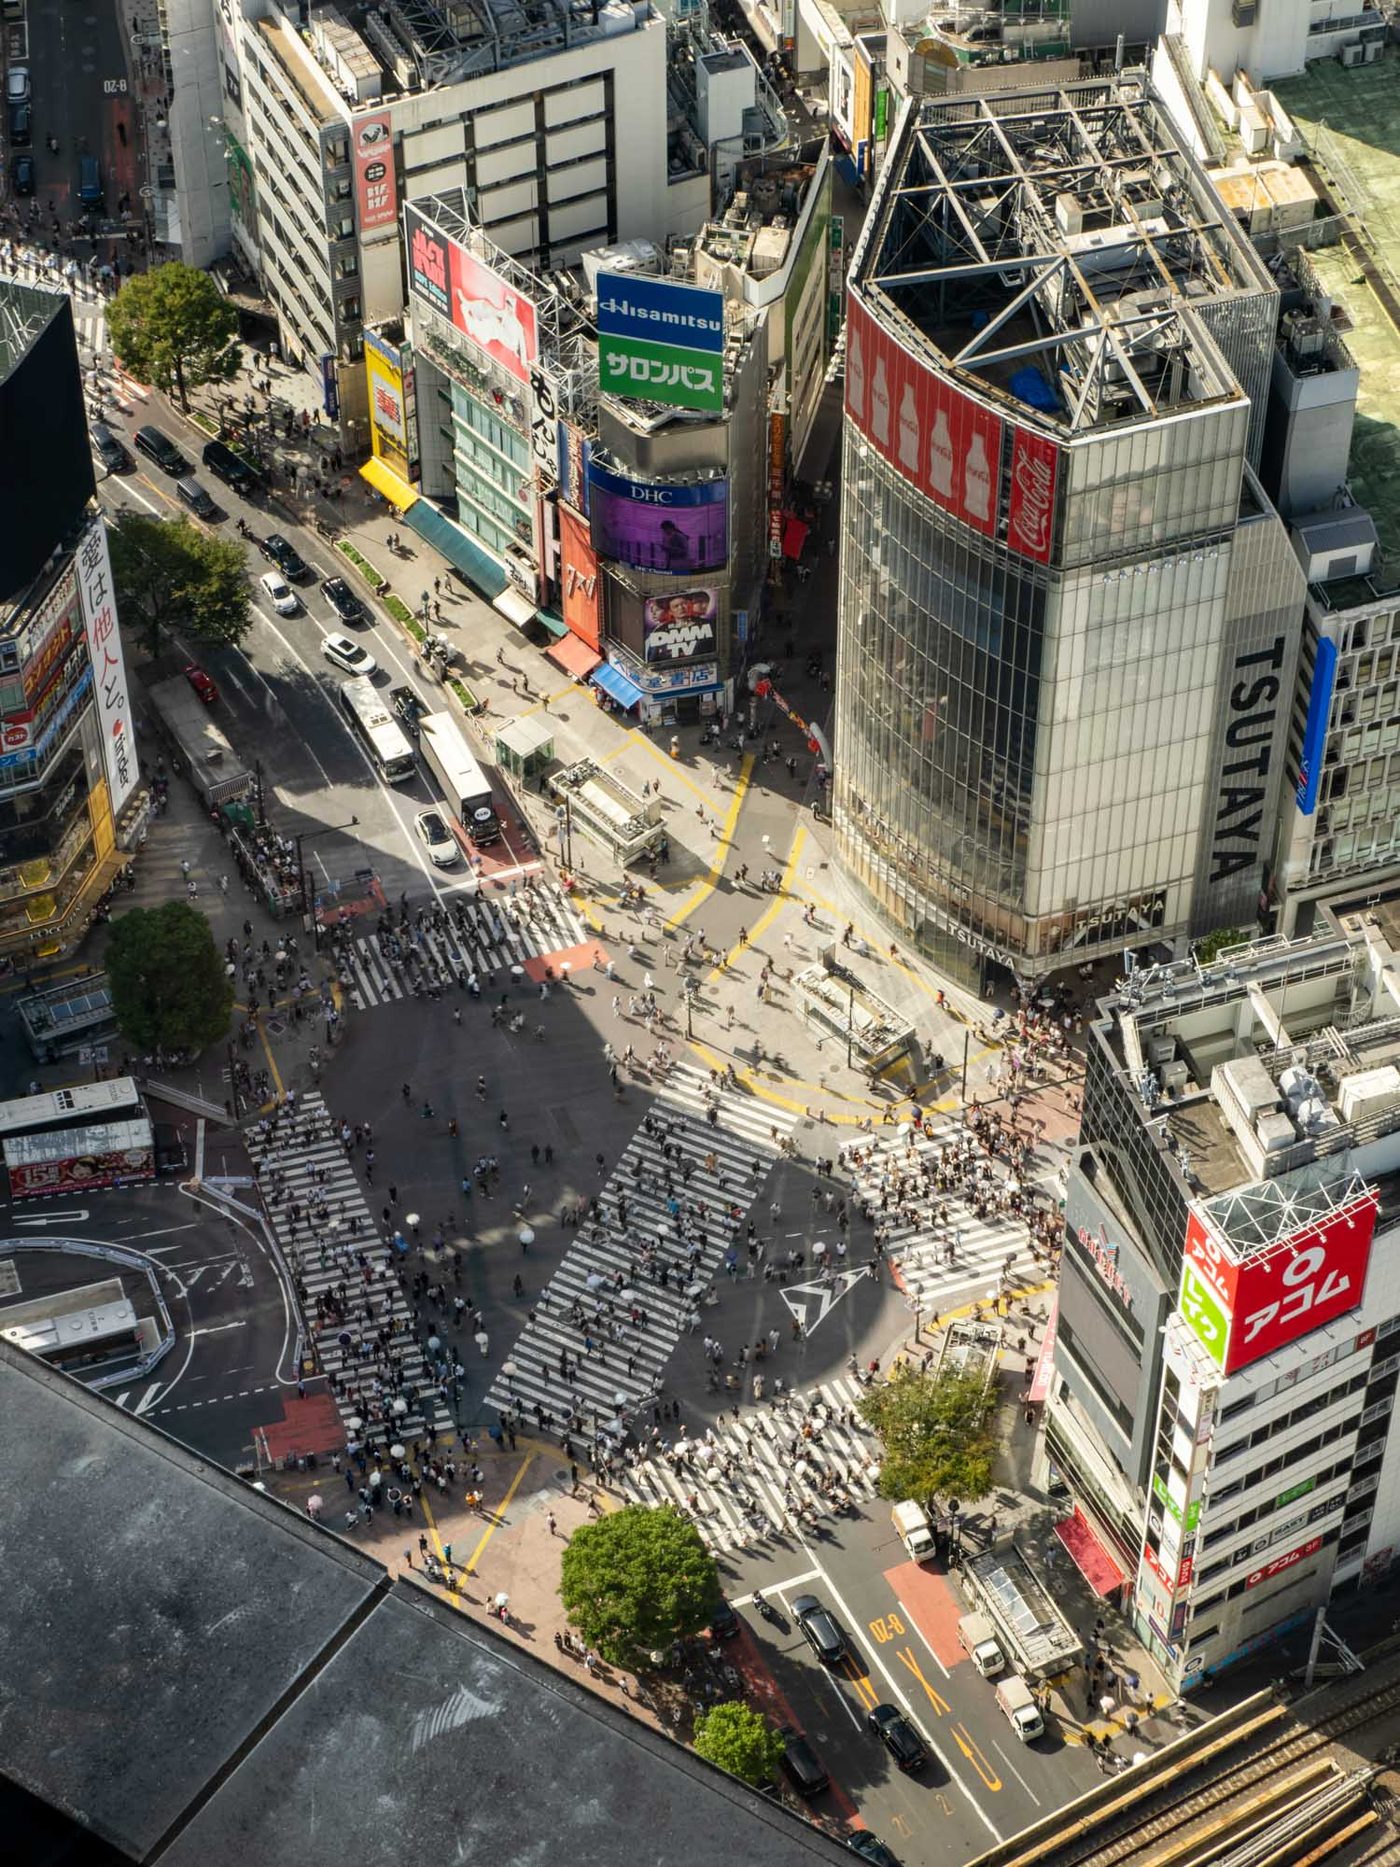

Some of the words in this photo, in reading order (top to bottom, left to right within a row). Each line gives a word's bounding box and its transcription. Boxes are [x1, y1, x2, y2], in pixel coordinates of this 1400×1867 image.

[600, 298, 720, 331] Hisamitsu
[606, 352, 715, 394] サロンパス
[631, 485, 673, 504] DHC
[1013, 444, 1051, 552] Coca-Cola
[666, 640, 697, 658] TV
[1209, 636, 1285, 884] TSUTAYA
[1077, 900, 1164, 930] TSUTAYA
[948, 922, 1015, 972] TSUTAYA
[1191, 1238, 1229, 1301] アコム
[1184, 1273, 1218, 1340] レイク
[1244, 1269, 1351, 1344] アコム
[1267, 1552, 1301, 1575] アコム
[869, 1613, 905, 1643] 8-20
